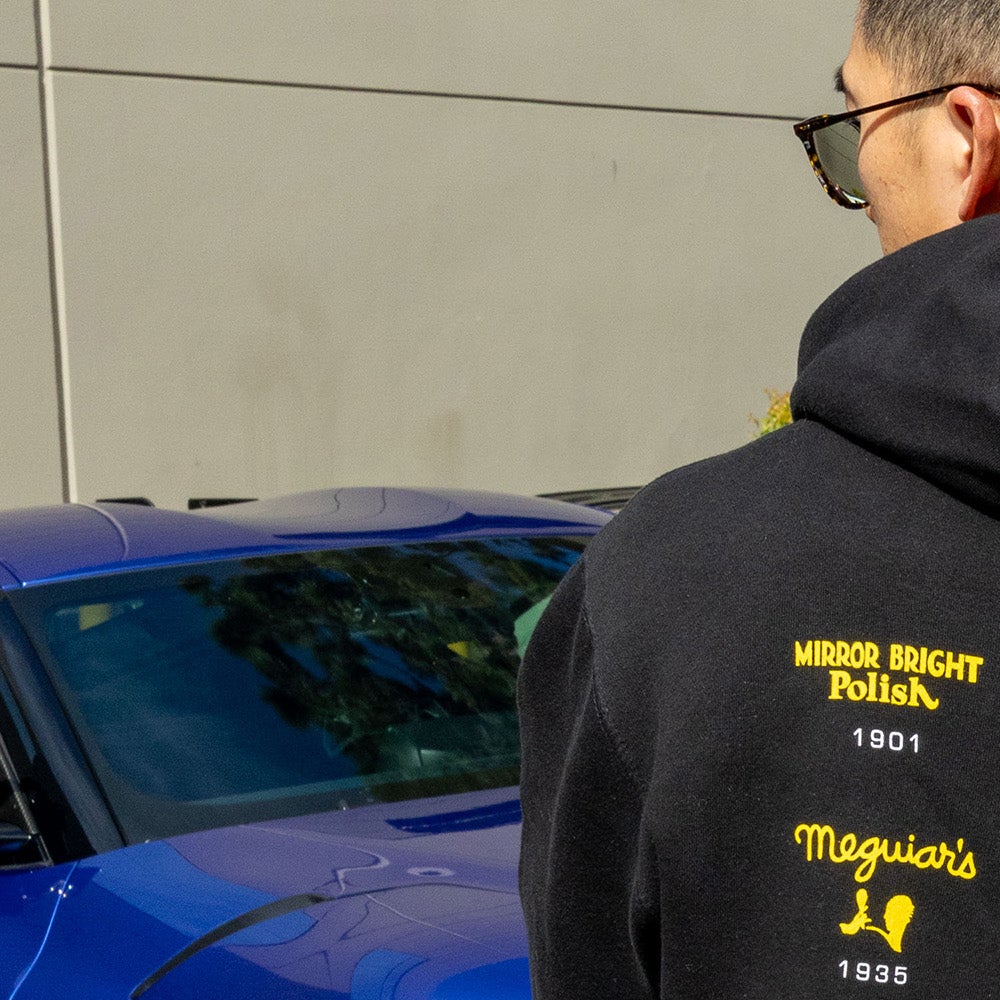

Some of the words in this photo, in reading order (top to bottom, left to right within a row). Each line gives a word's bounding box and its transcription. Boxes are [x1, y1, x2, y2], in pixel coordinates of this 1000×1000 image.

[793, 638, 882, 669] MIRROR
[888, 641, 985, 684] BRIGHT
[827, 669, 940, 711] Polish
[852, 727, 919, 754] 1901
[793, 822, 978, 883] Meguiar's
[838, 959, 908, 985] 1935
